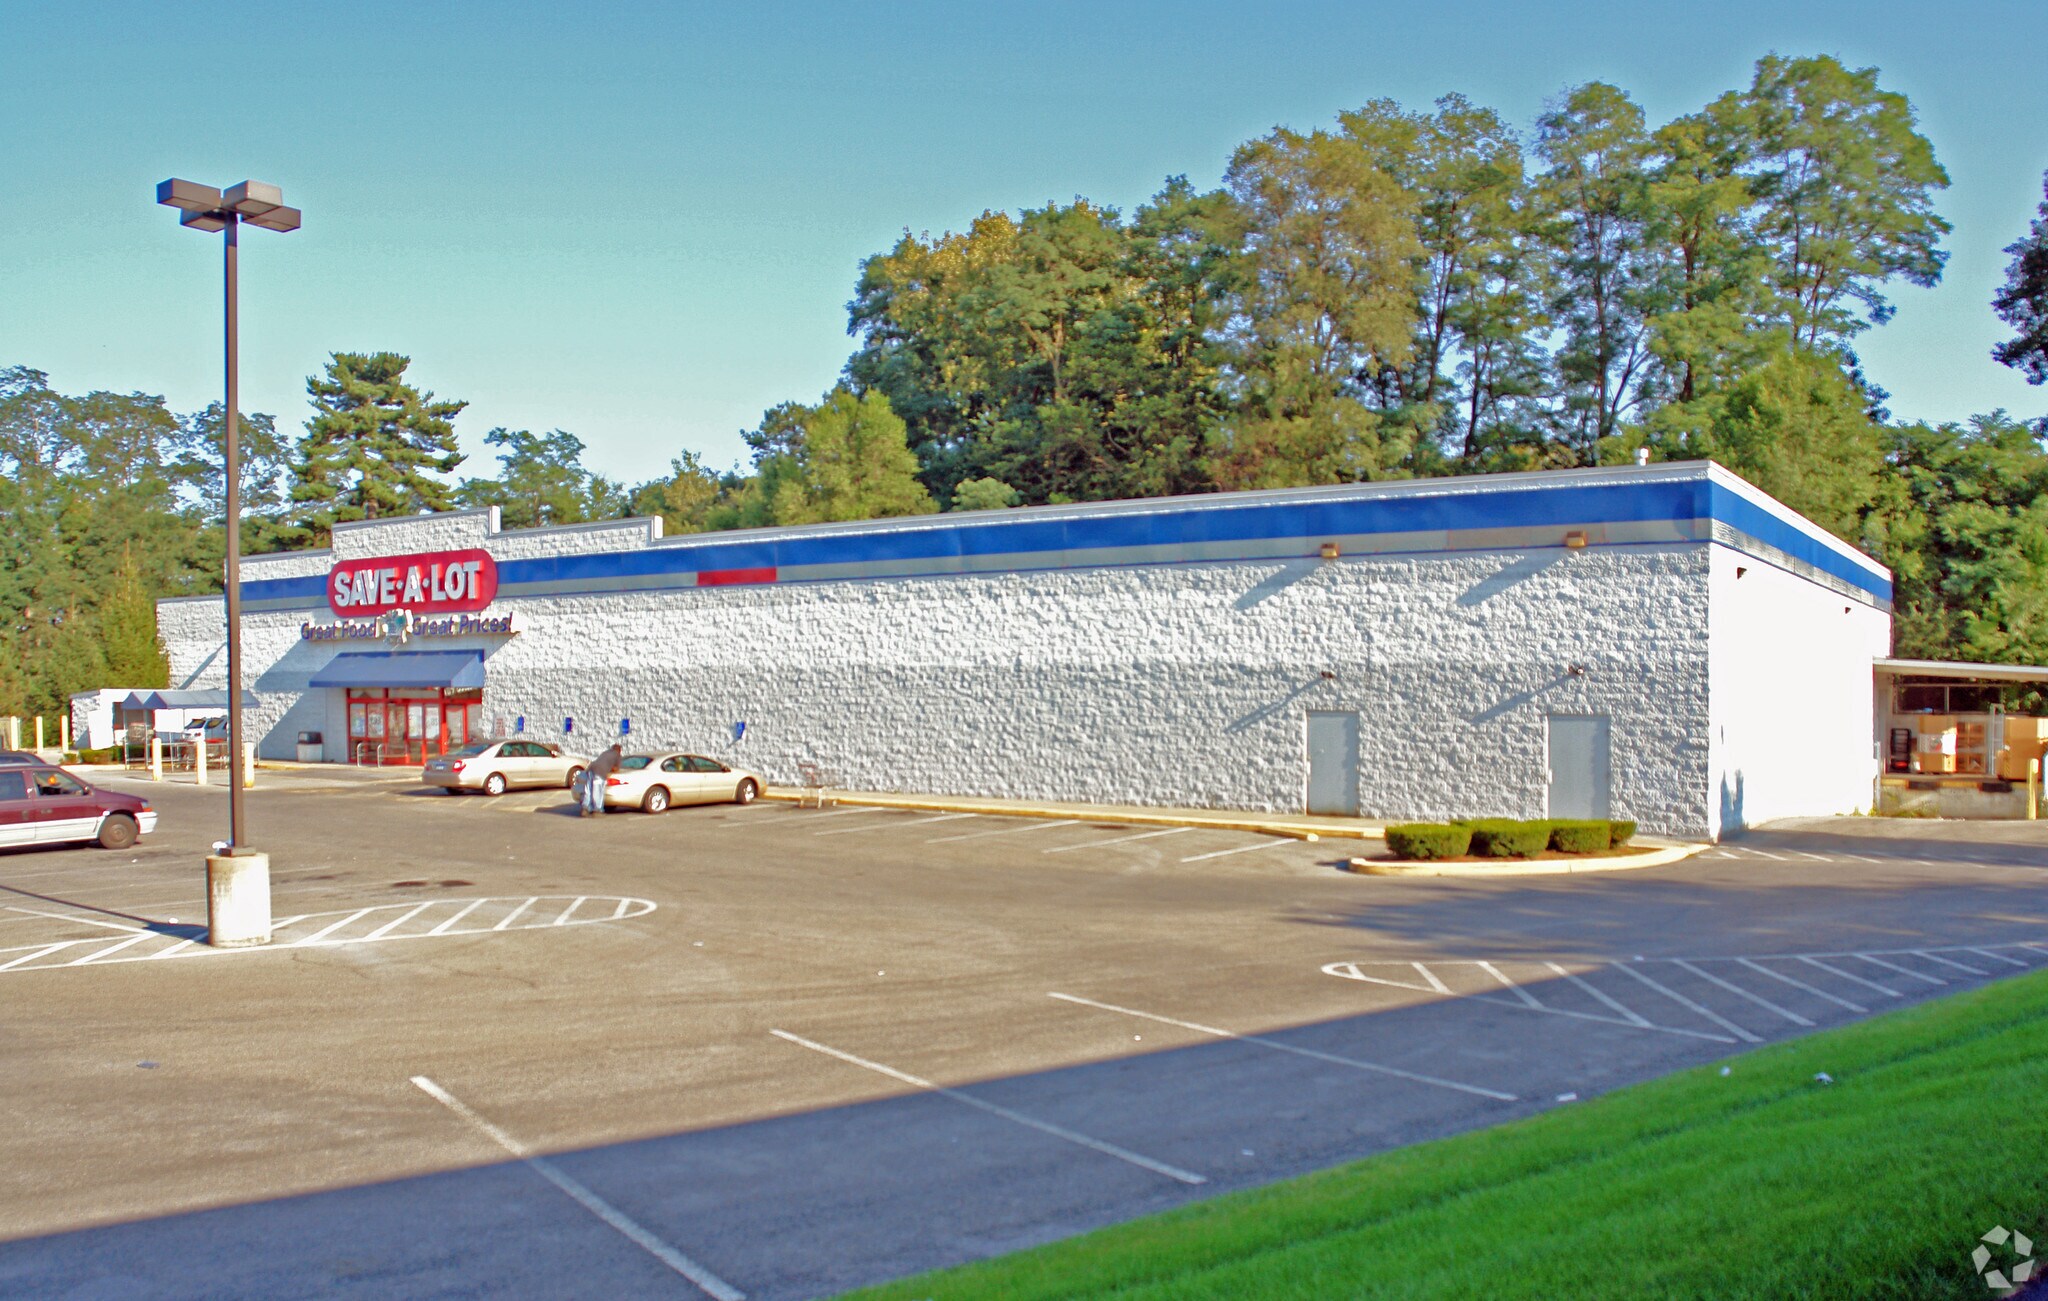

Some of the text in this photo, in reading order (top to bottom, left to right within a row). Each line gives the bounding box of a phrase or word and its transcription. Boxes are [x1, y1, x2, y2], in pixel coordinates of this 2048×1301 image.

[300, 611, 513, 640] Great Food Great Prices!
